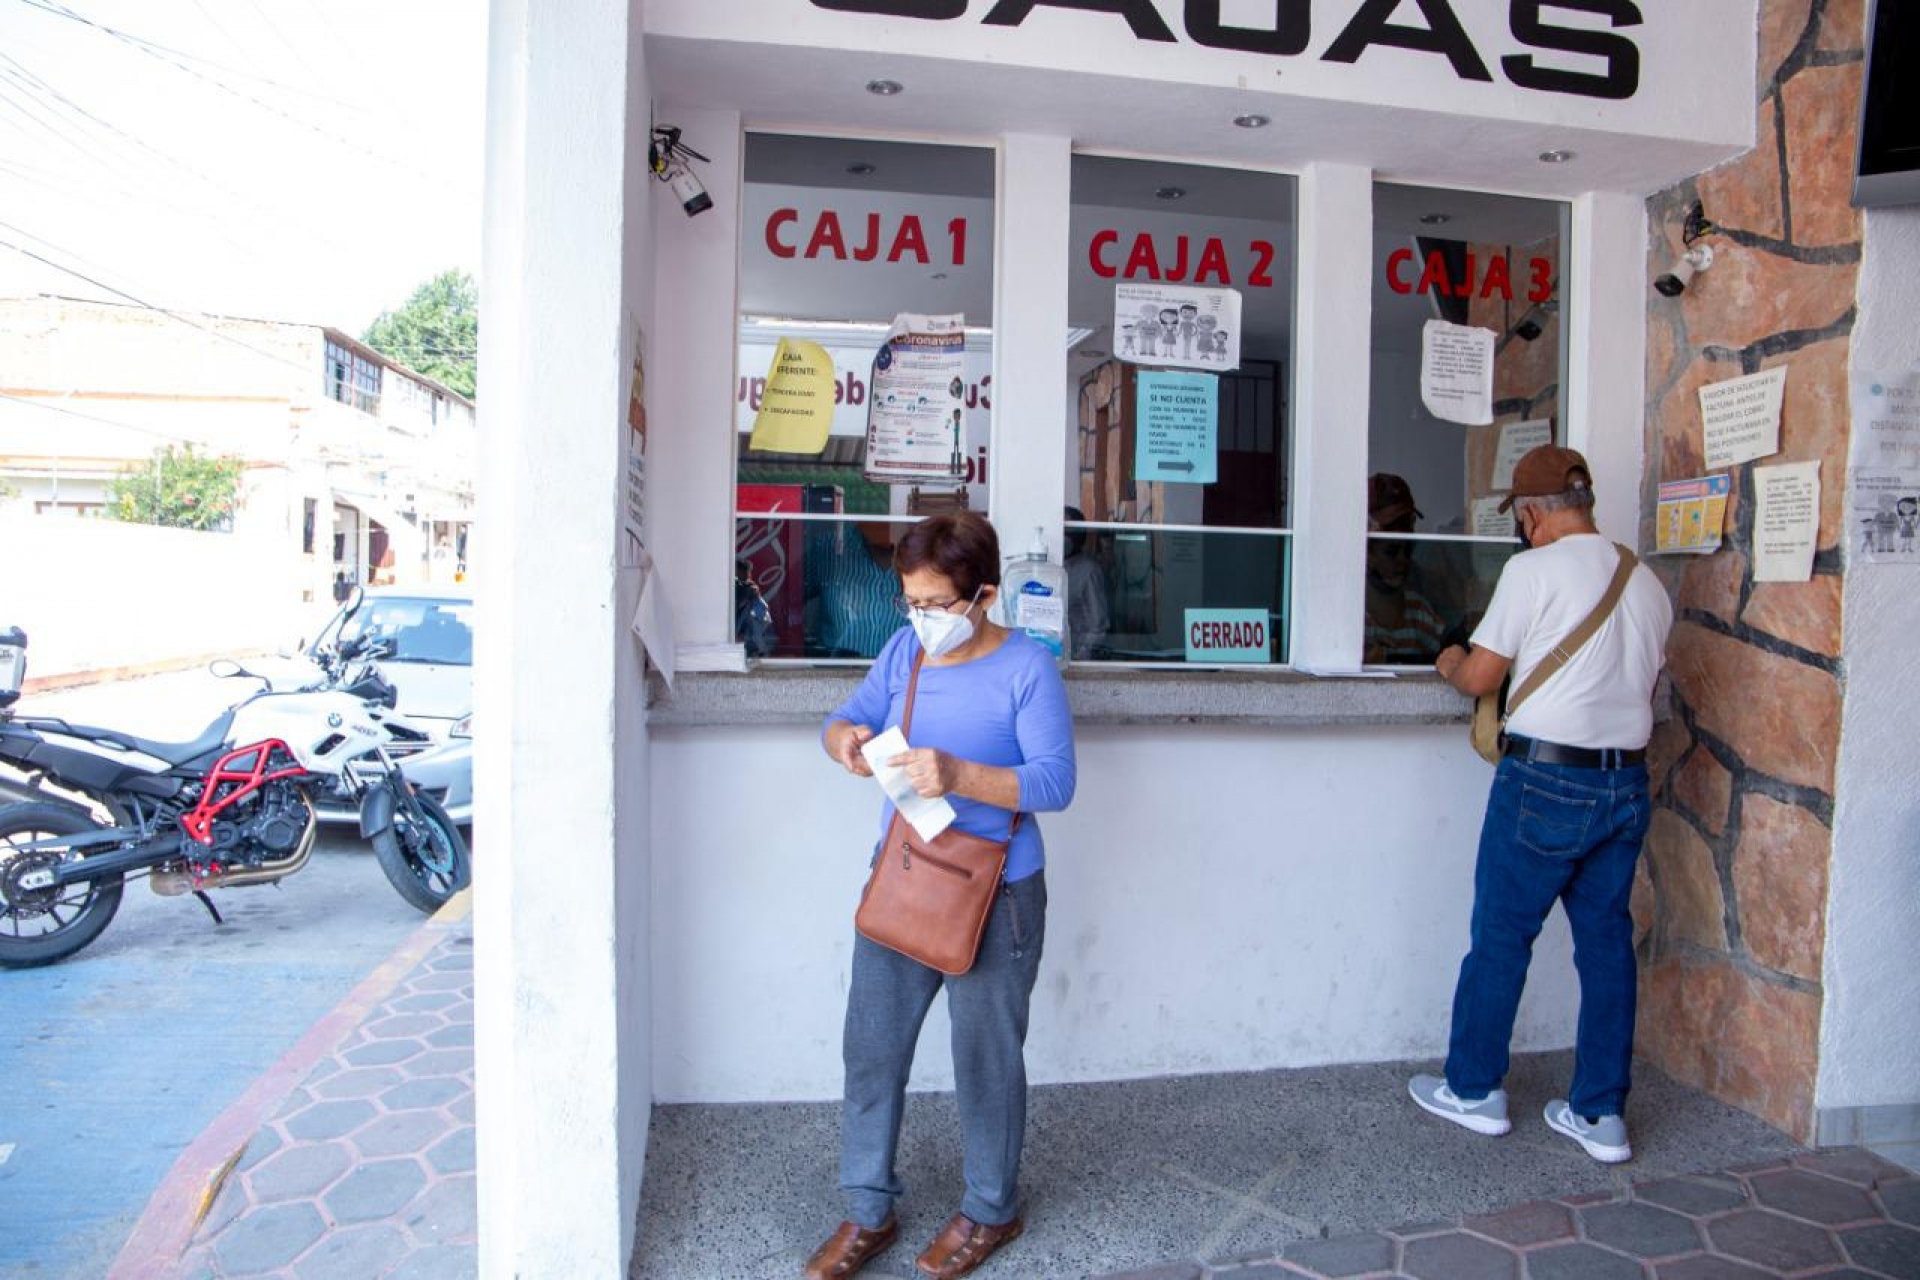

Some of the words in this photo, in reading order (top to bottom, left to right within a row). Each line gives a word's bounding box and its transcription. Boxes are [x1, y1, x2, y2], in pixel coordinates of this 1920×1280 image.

[809, 0, 1643, 99] JAS
[765, 207, 930, 264] CAJA
[947, 217, 967, 265] 1
[1089, 229, 1231, 285] CAJA
[1248, 239, 1275, 287] 2
[1386, 247, 1512, 301] CAJA
[1528, 257, 1551, 303] 3
[782, 353, 802, 361] CAJA
[1190, 621, 1264, 649] CERRADO
